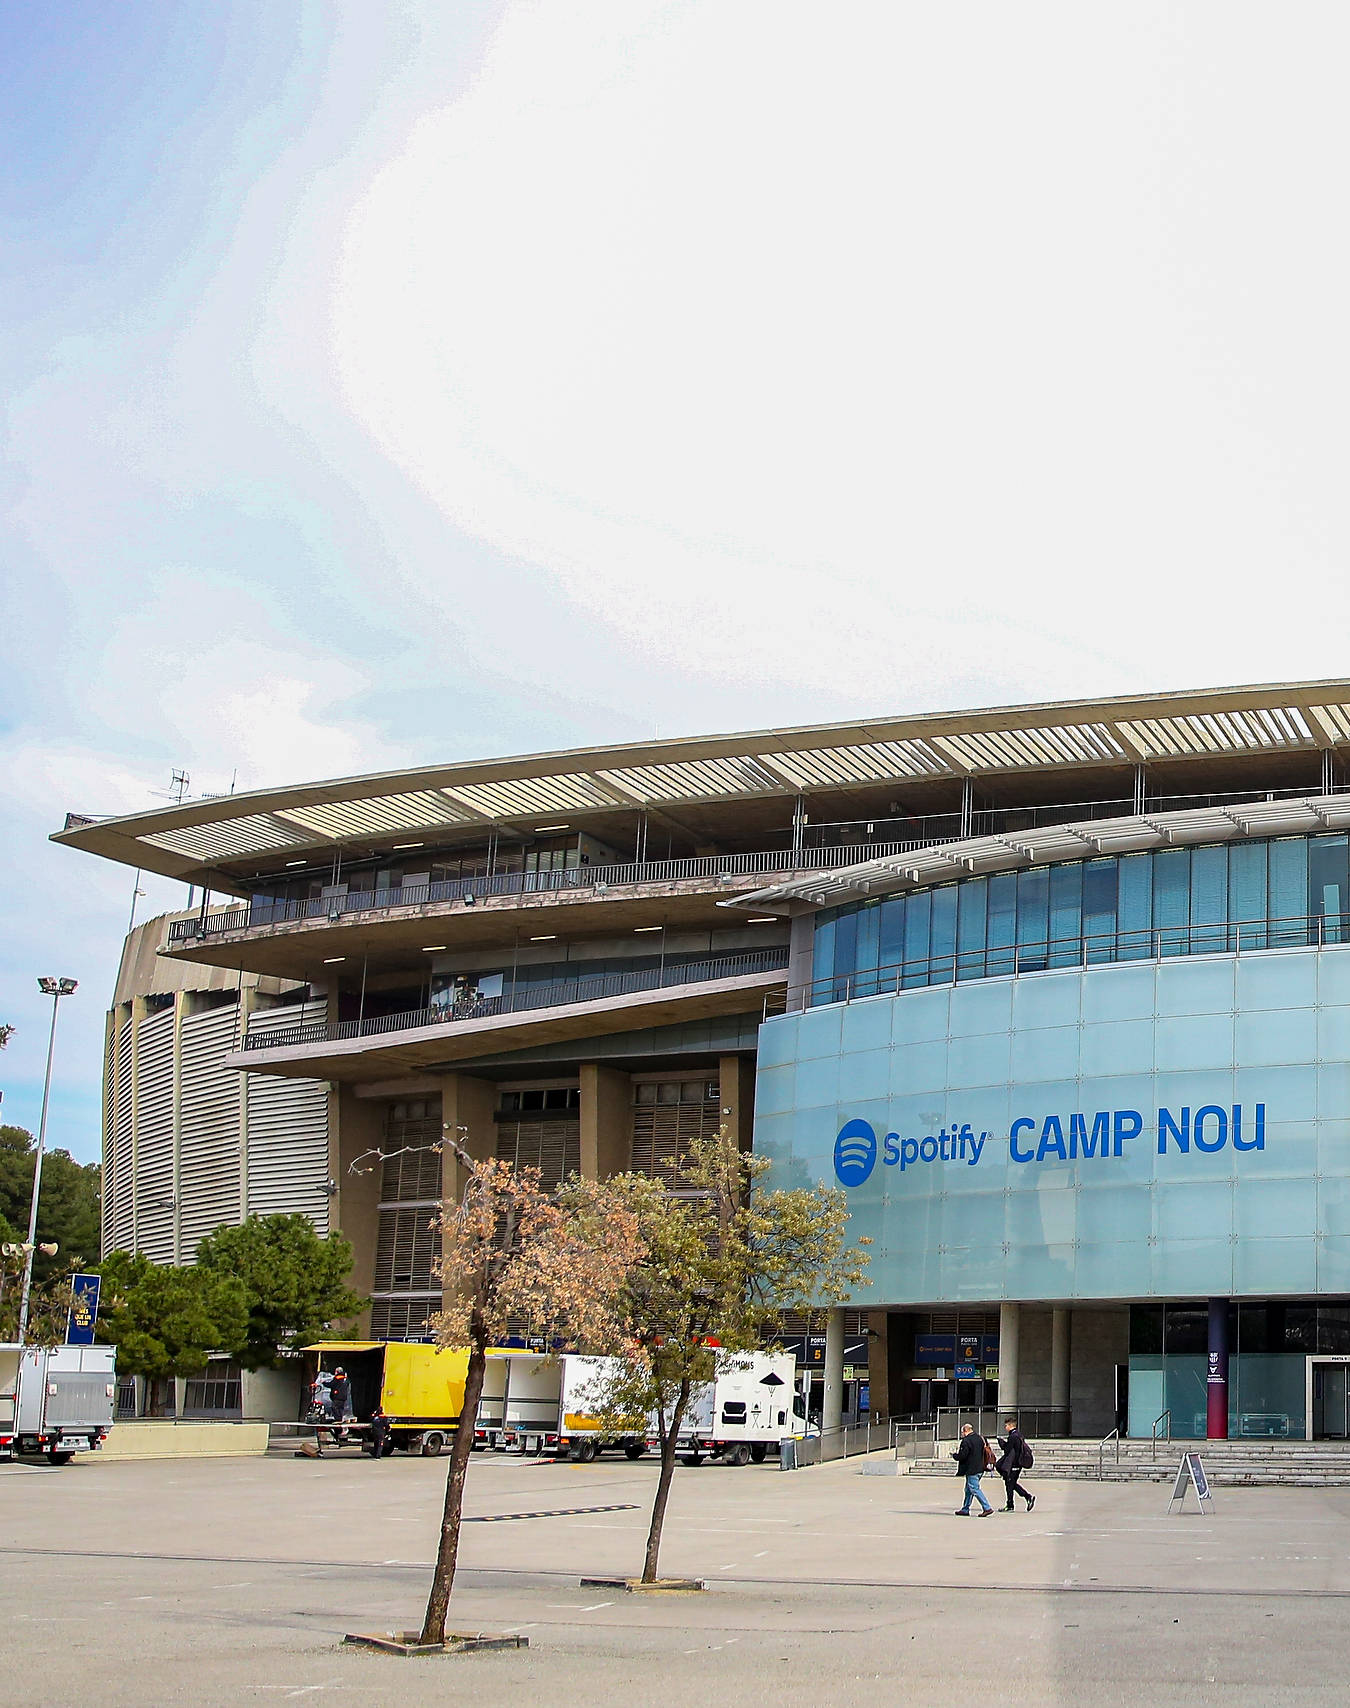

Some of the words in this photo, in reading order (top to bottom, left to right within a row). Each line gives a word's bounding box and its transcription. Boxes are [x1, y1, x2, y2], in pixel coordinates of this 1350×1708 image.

[883, 1124, 987, 1171] Spotify
[1009, 1109, 1142, 1163] CAMP
[1157, 1103, 1265, 1154] NOU
[814, 1349, 822, 1360] 5
[965, 1346, 973, 1357] 6
